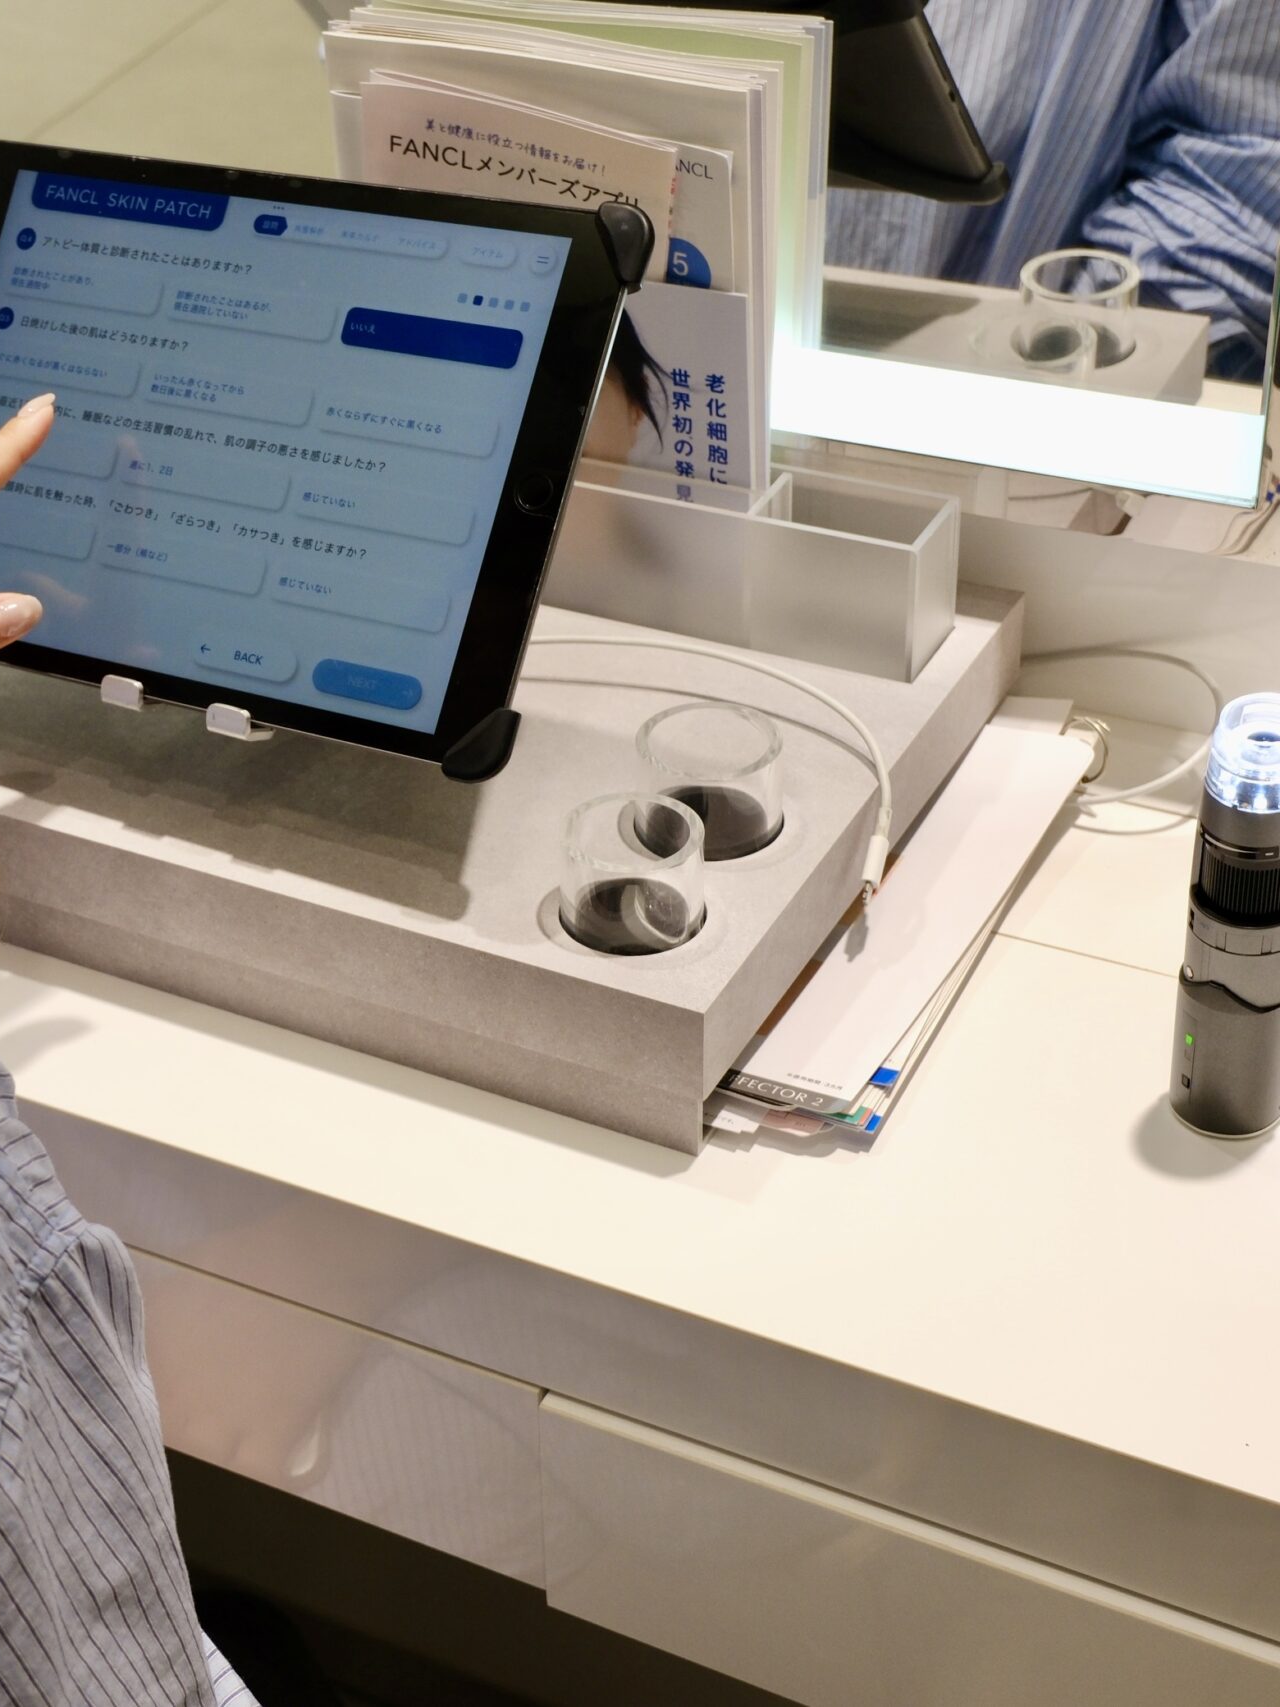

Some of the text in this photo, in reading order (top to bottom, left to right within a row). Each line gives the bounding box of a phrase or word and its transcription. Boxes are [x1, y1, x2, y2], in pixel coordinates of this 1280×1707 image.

[45, 184, 213, 219] FANCL SKIN PATCH
[20, 315, 189, 350] 日焼けした後の肌はどうなりますか?
[349, 321, 376, 335] いいえ
[704, 373, 728, 485] 老化細胞に
[233, 650, 264, 667] BACK
